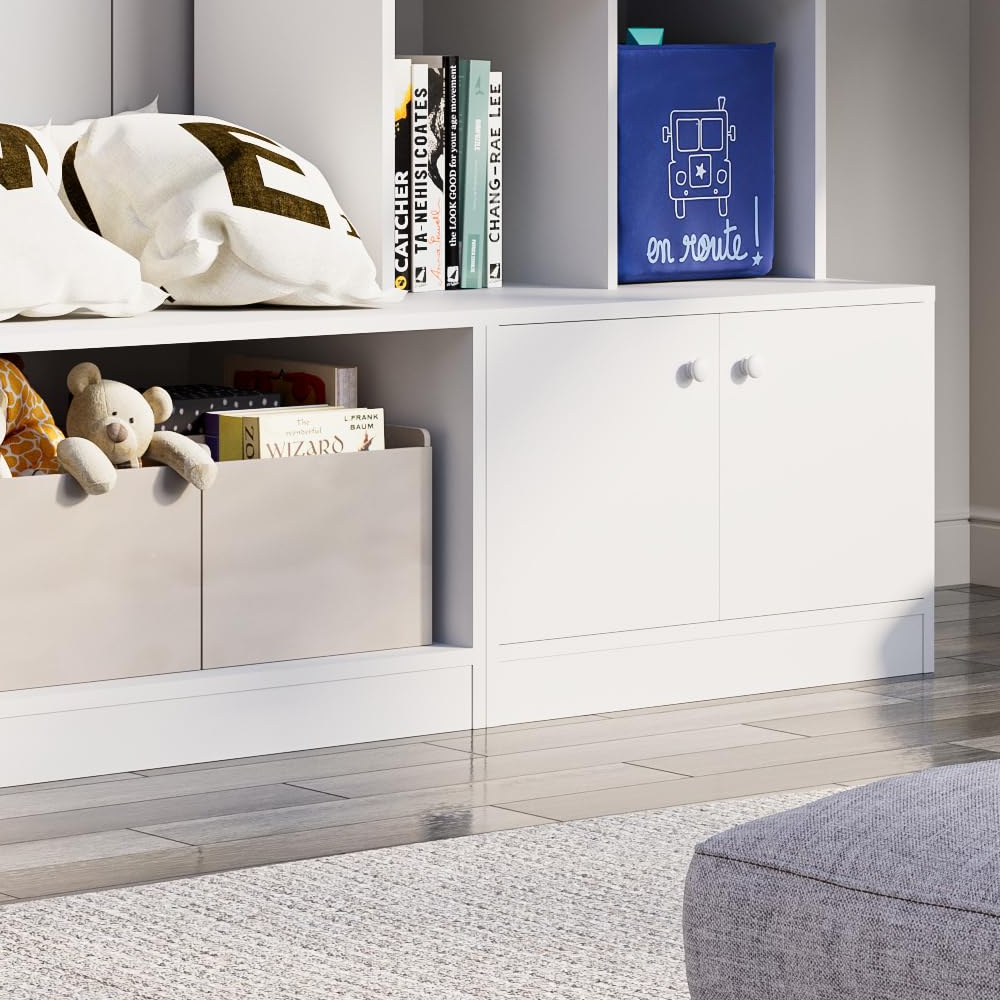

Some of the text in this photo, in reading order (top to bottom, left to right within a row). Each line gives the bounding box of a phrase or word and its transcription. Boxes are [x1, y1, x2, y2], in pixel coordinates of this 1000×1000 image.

[179, 122, 331, 229] E
[414, 87, 428, 254] TA-NEHISI COATES
[448, 65, 459, 247] the LOOK GOOD for your age movement
[488, 83, 501, 243] CHANG-RAE LEE
[395, 171, 409, 273] CATCHER
[647, 236, 675, 263] en
[266, 435, 345, 459] WIZARD
[350, 423, 375, 431] BAUM
